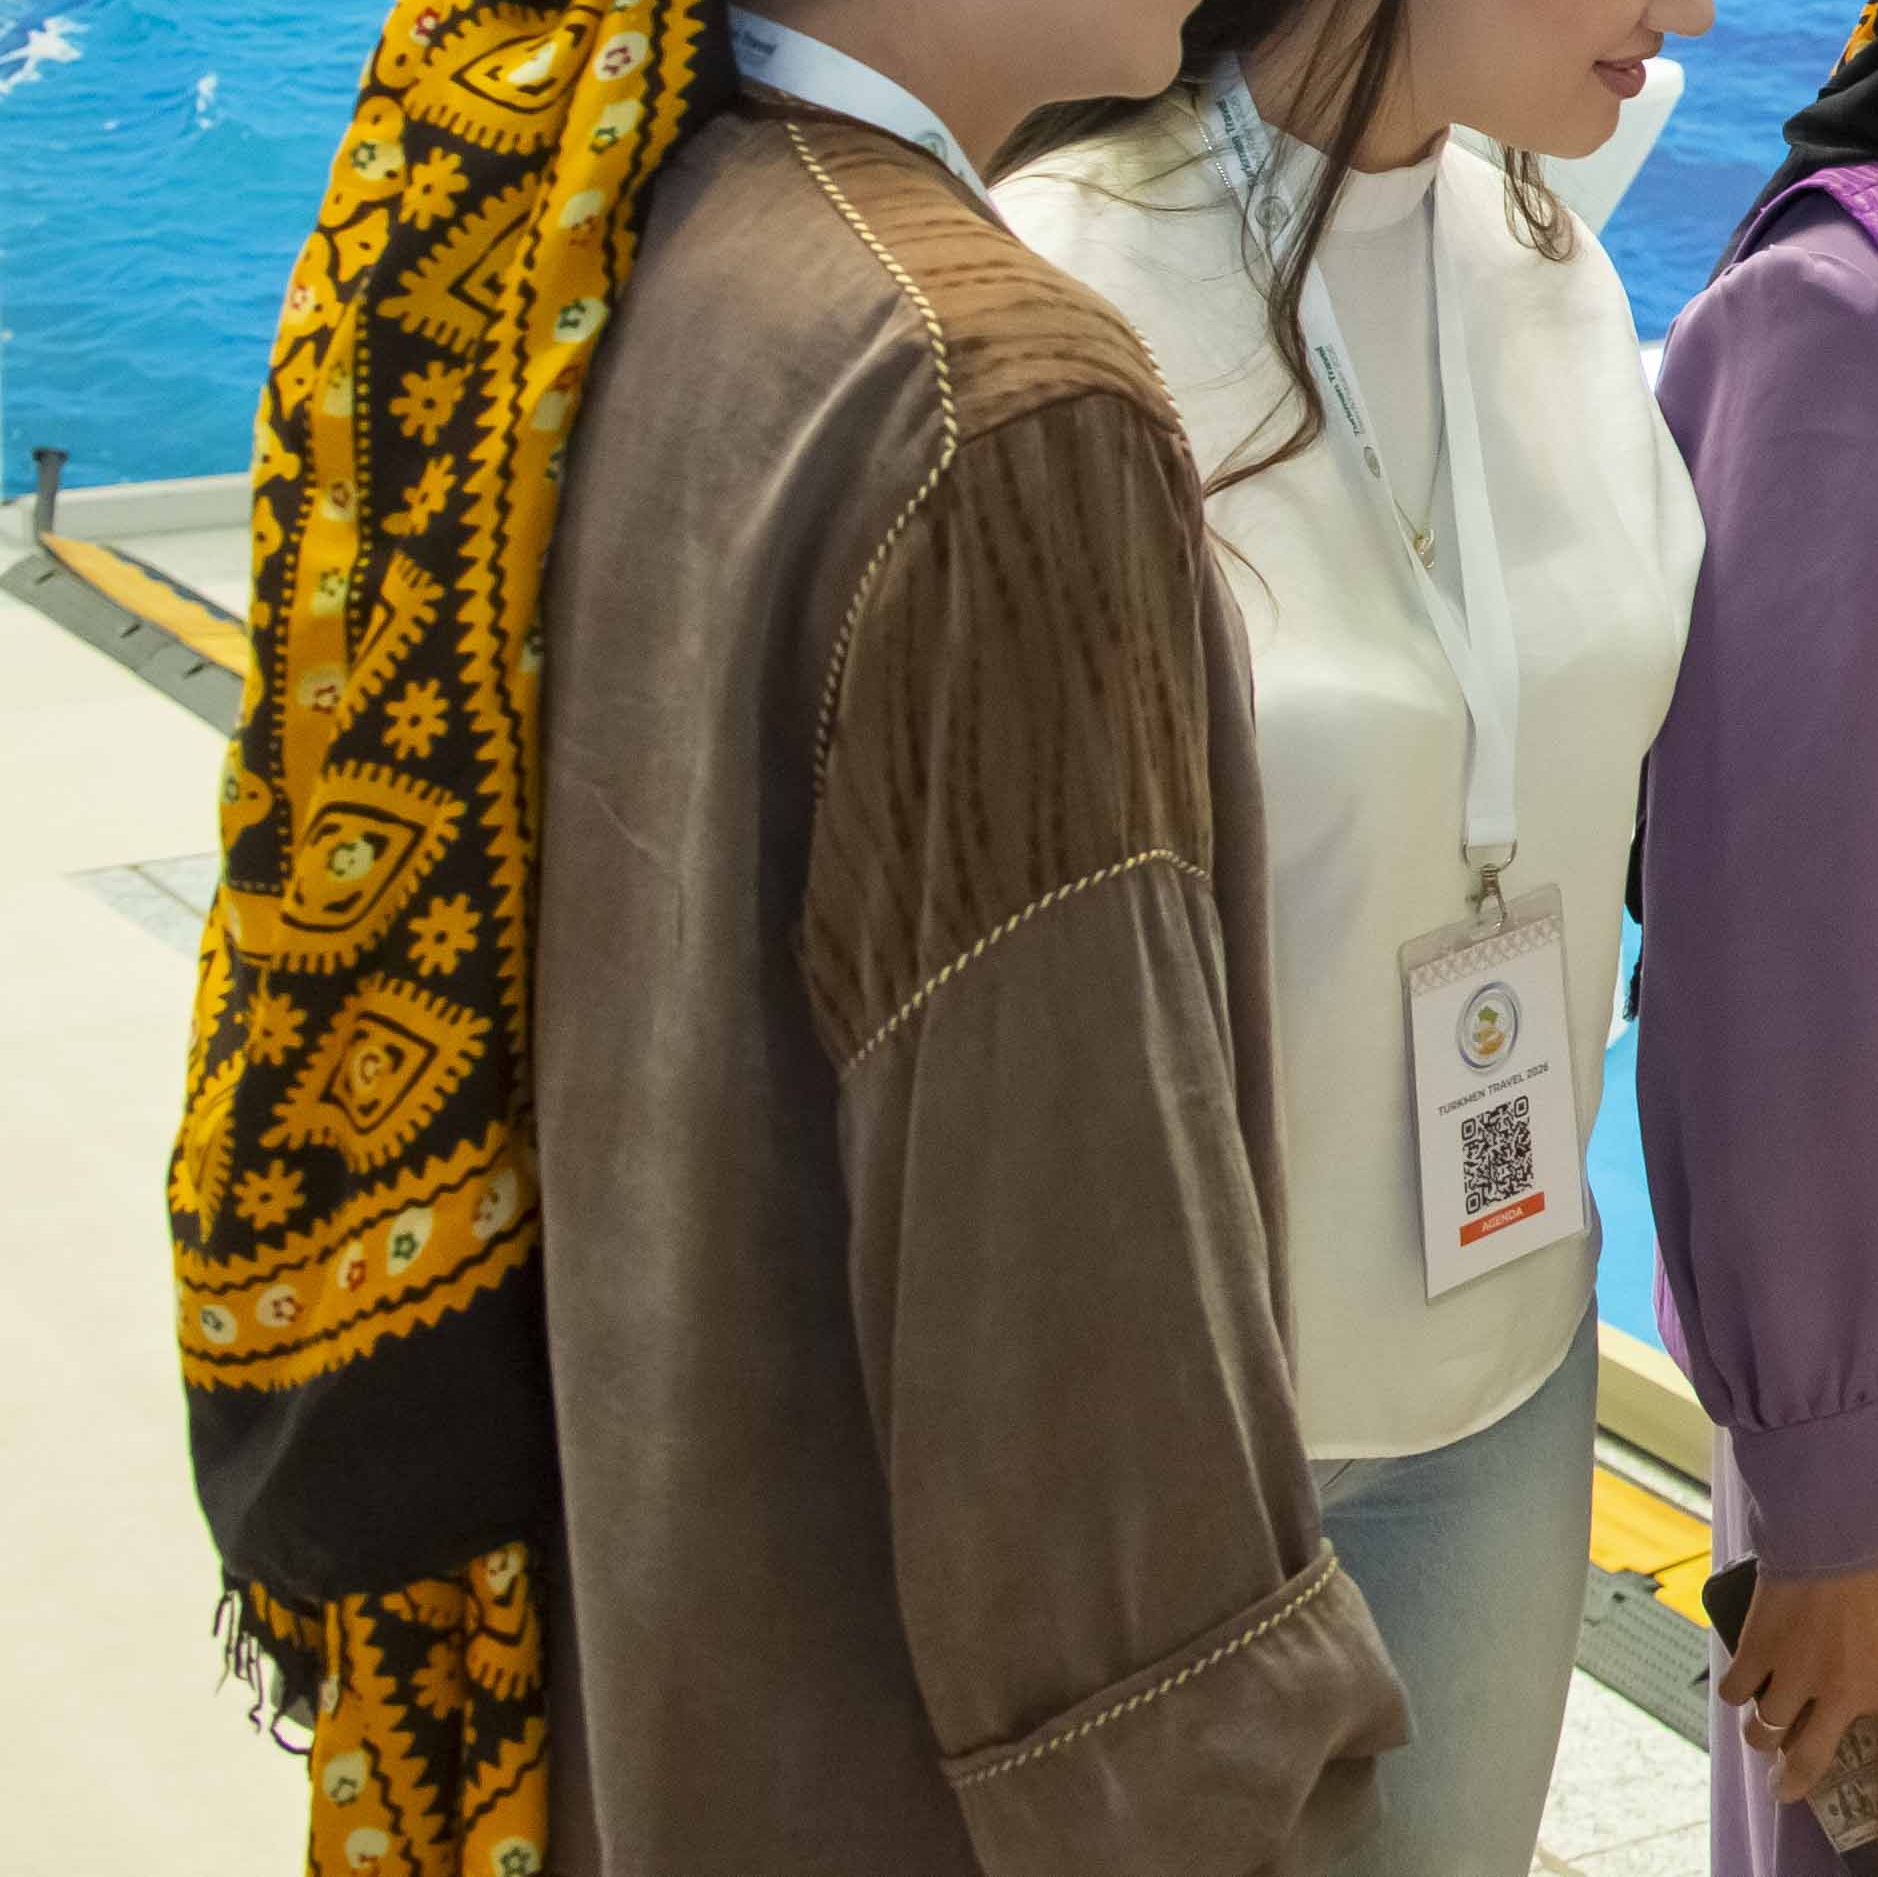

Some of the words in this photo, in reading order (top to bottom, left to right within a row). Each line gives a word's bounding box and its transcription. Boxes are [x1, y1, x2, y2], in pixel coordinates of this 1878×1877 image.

[1437, 1088, 1486, 1117] TURKMEN
[1487, 1073, 1525, 1097] TRAVEL
[1480, 1206, 1523, 1233] AGENDA
